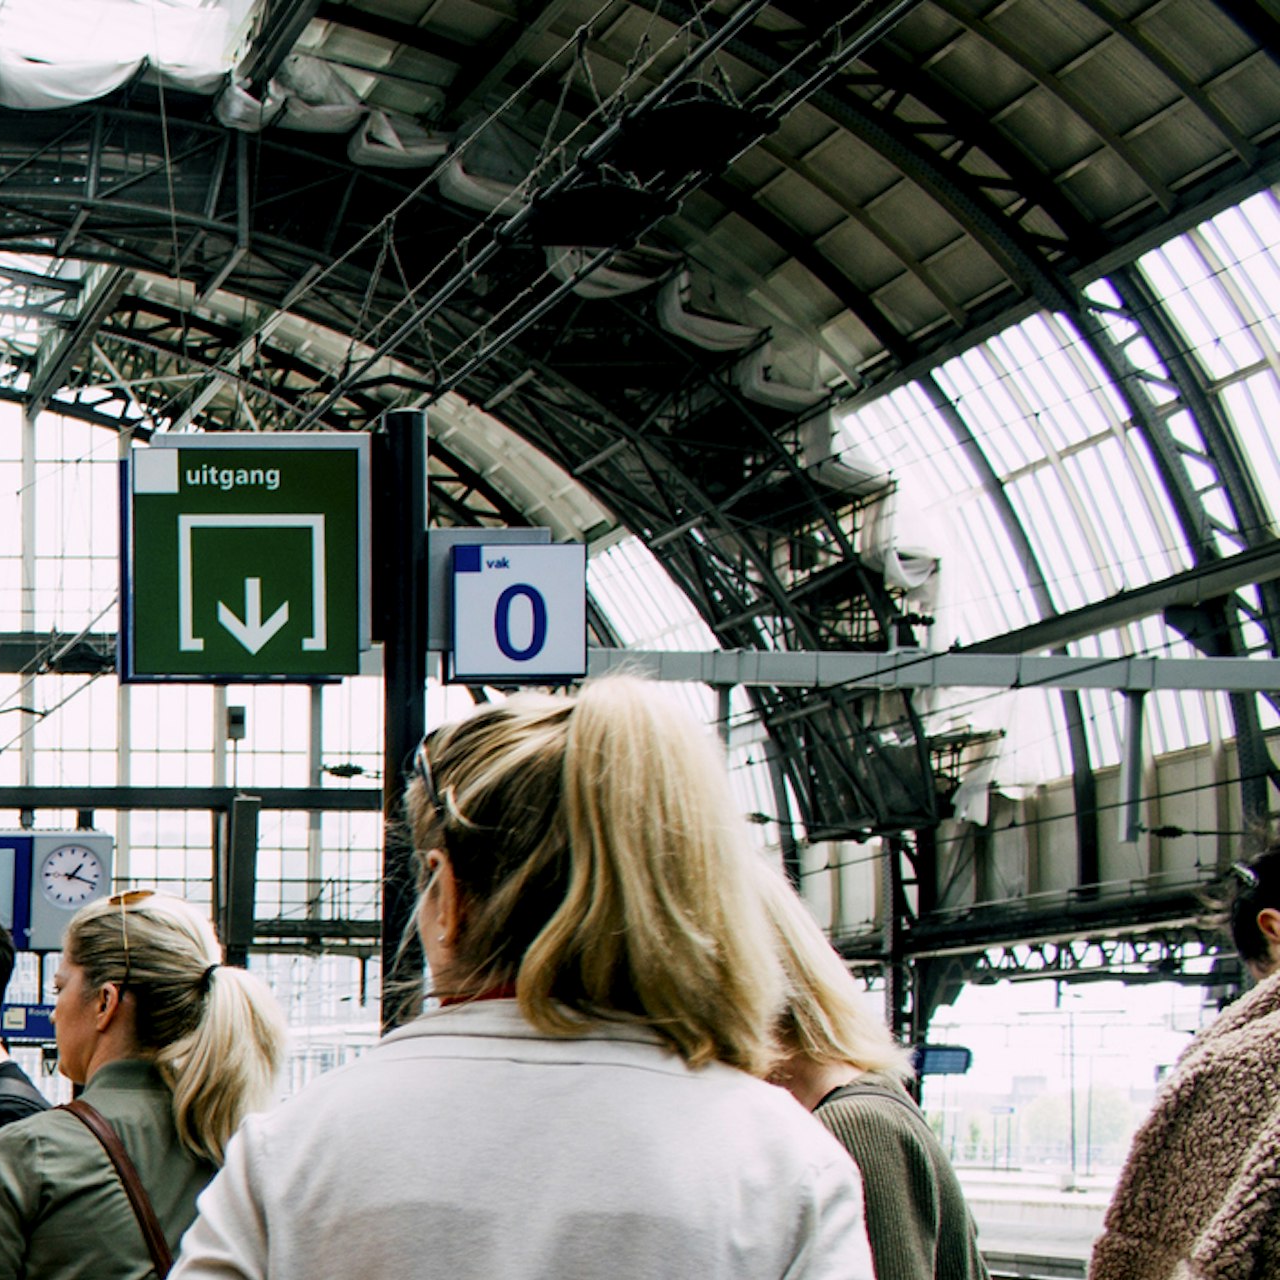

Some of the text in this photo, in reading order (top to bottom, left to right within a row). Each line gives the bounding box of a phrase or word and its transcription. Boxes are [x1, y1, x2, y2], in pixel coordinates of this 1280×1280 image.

[186, 464, 280, 490] uitgang
[486, 557, 510, 569] vak
[494, 583, 548, 662] 0
